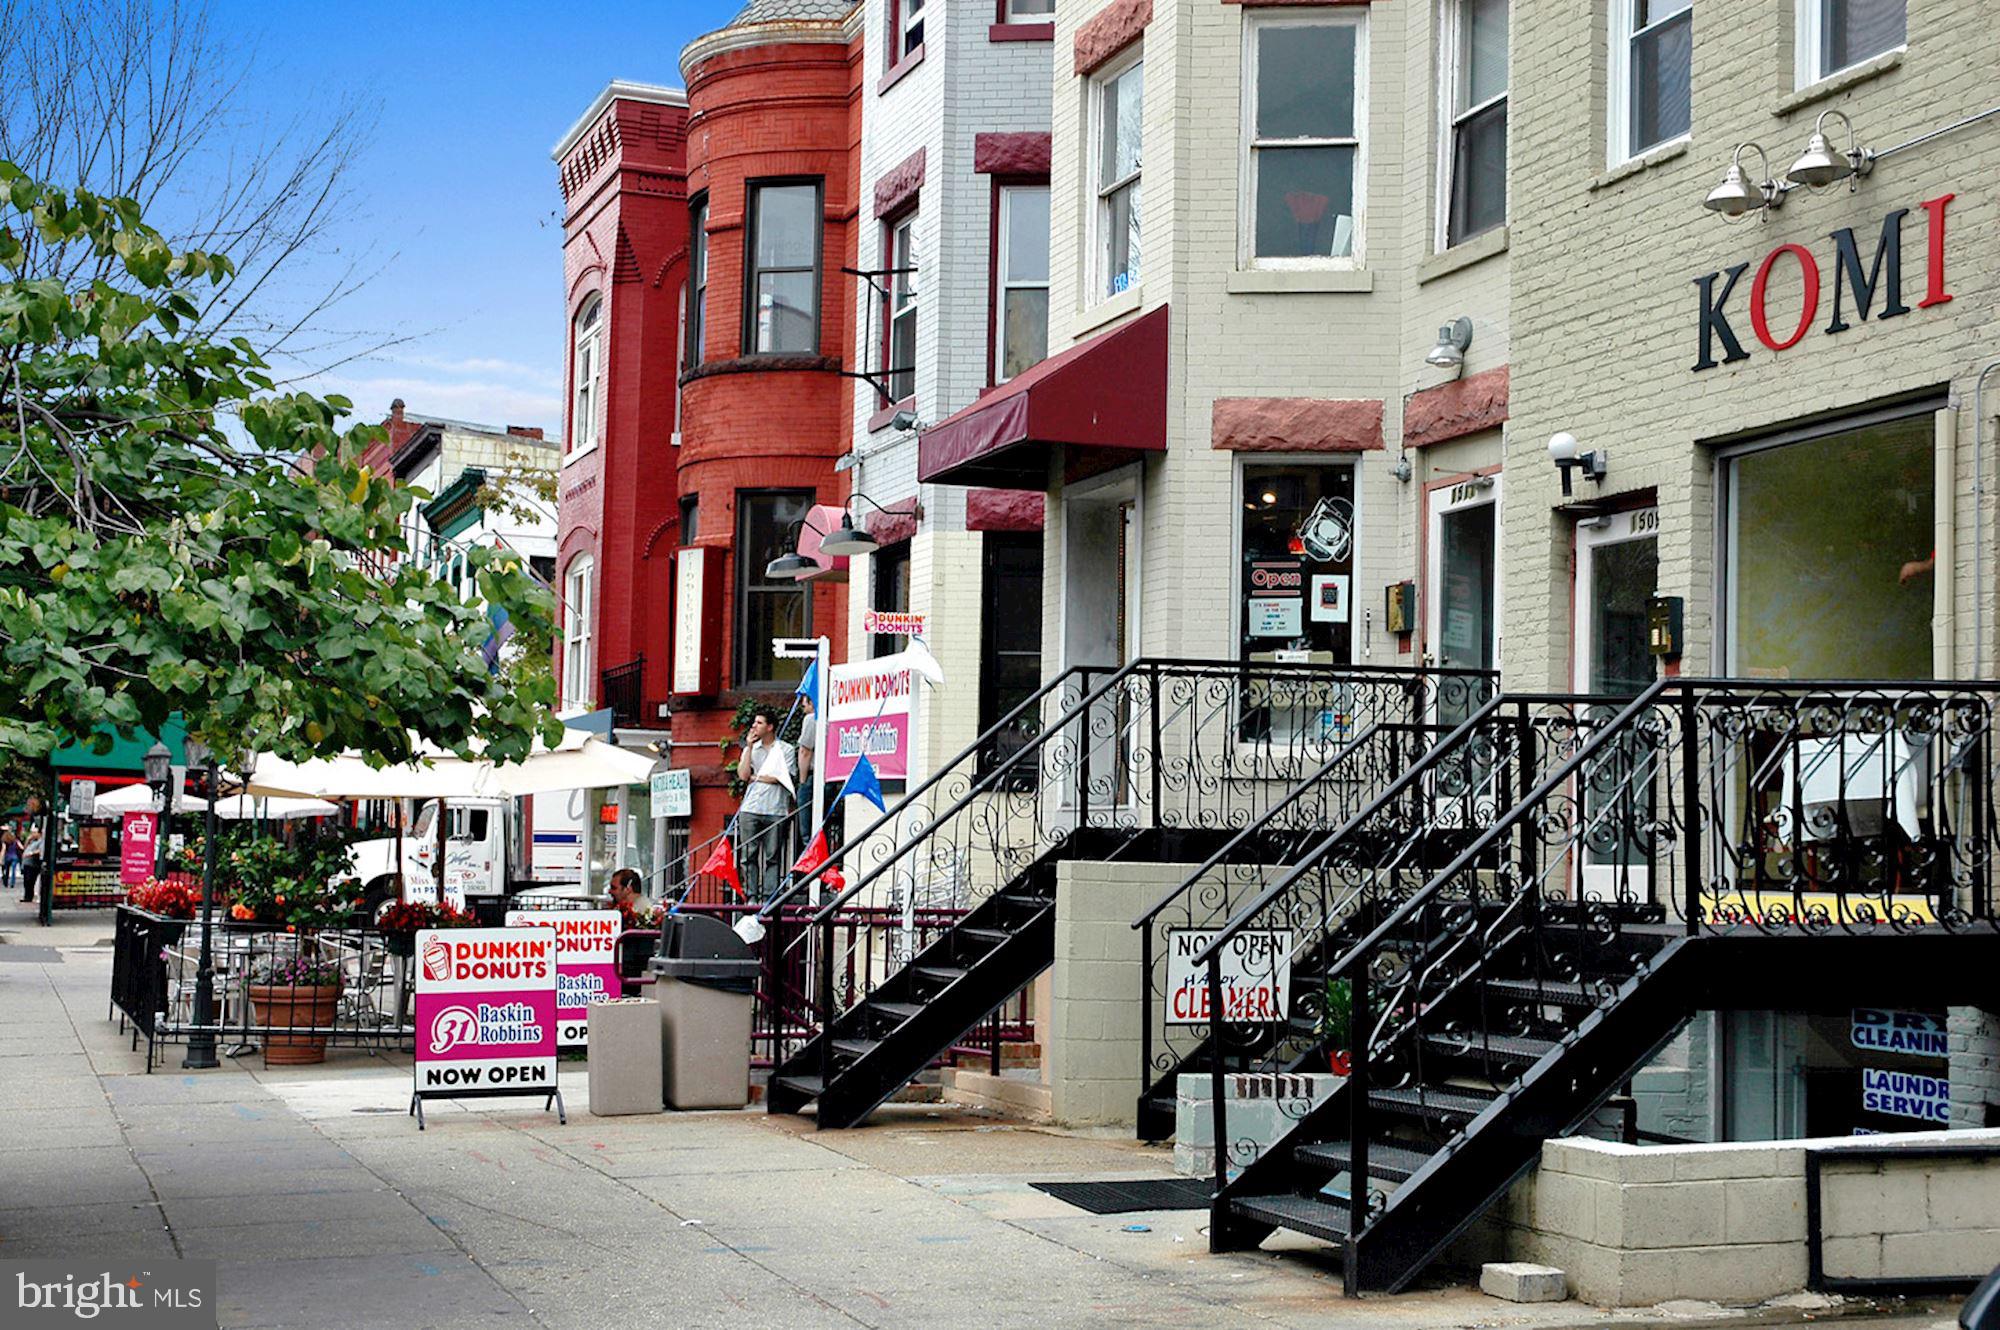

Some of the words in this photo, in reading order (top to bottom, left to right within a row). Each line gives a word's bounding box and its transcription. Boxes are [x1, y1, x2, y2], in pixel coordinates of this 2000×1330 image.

[1690, 193, 1956, 372] KOMI
[1251, 569, 1301, 589] Open
[878, 613, 926, 623] DUNKIN'
[878, 623, 923, 633] DONUTS
[875, 669, 911, 700] DONUTS
[424, 886, 459, 894] PSHIC
[539, 920, 618, 936] UNKIN'
[456, 940, 552, 960] DUNKIN'
[556, 937, 613, 952] ONUTS
[1178, 935, 1213, 956] NO
[1233, 935, 1283, 956] OPEN
[456, 961, 547, 980] DONUTS
[558, 975, 602, 990] Baskin
[434, 1019, 472, 1051] 31
[480, 1005, 533, 1022] Baskin
[480, 1025, 540, 1043] Robbins
[564, 1026, 588, 1039] OP
[1853, 1026, 1947, 1054] CLEANIN
[427, 1068, 481, 1085] NOW
[488, 1066, 546, 1083] OPEN
[1866, 1071, 1949, 1100] LAUNDR
[1866, 1093, 1949, 1121] SERVIC
